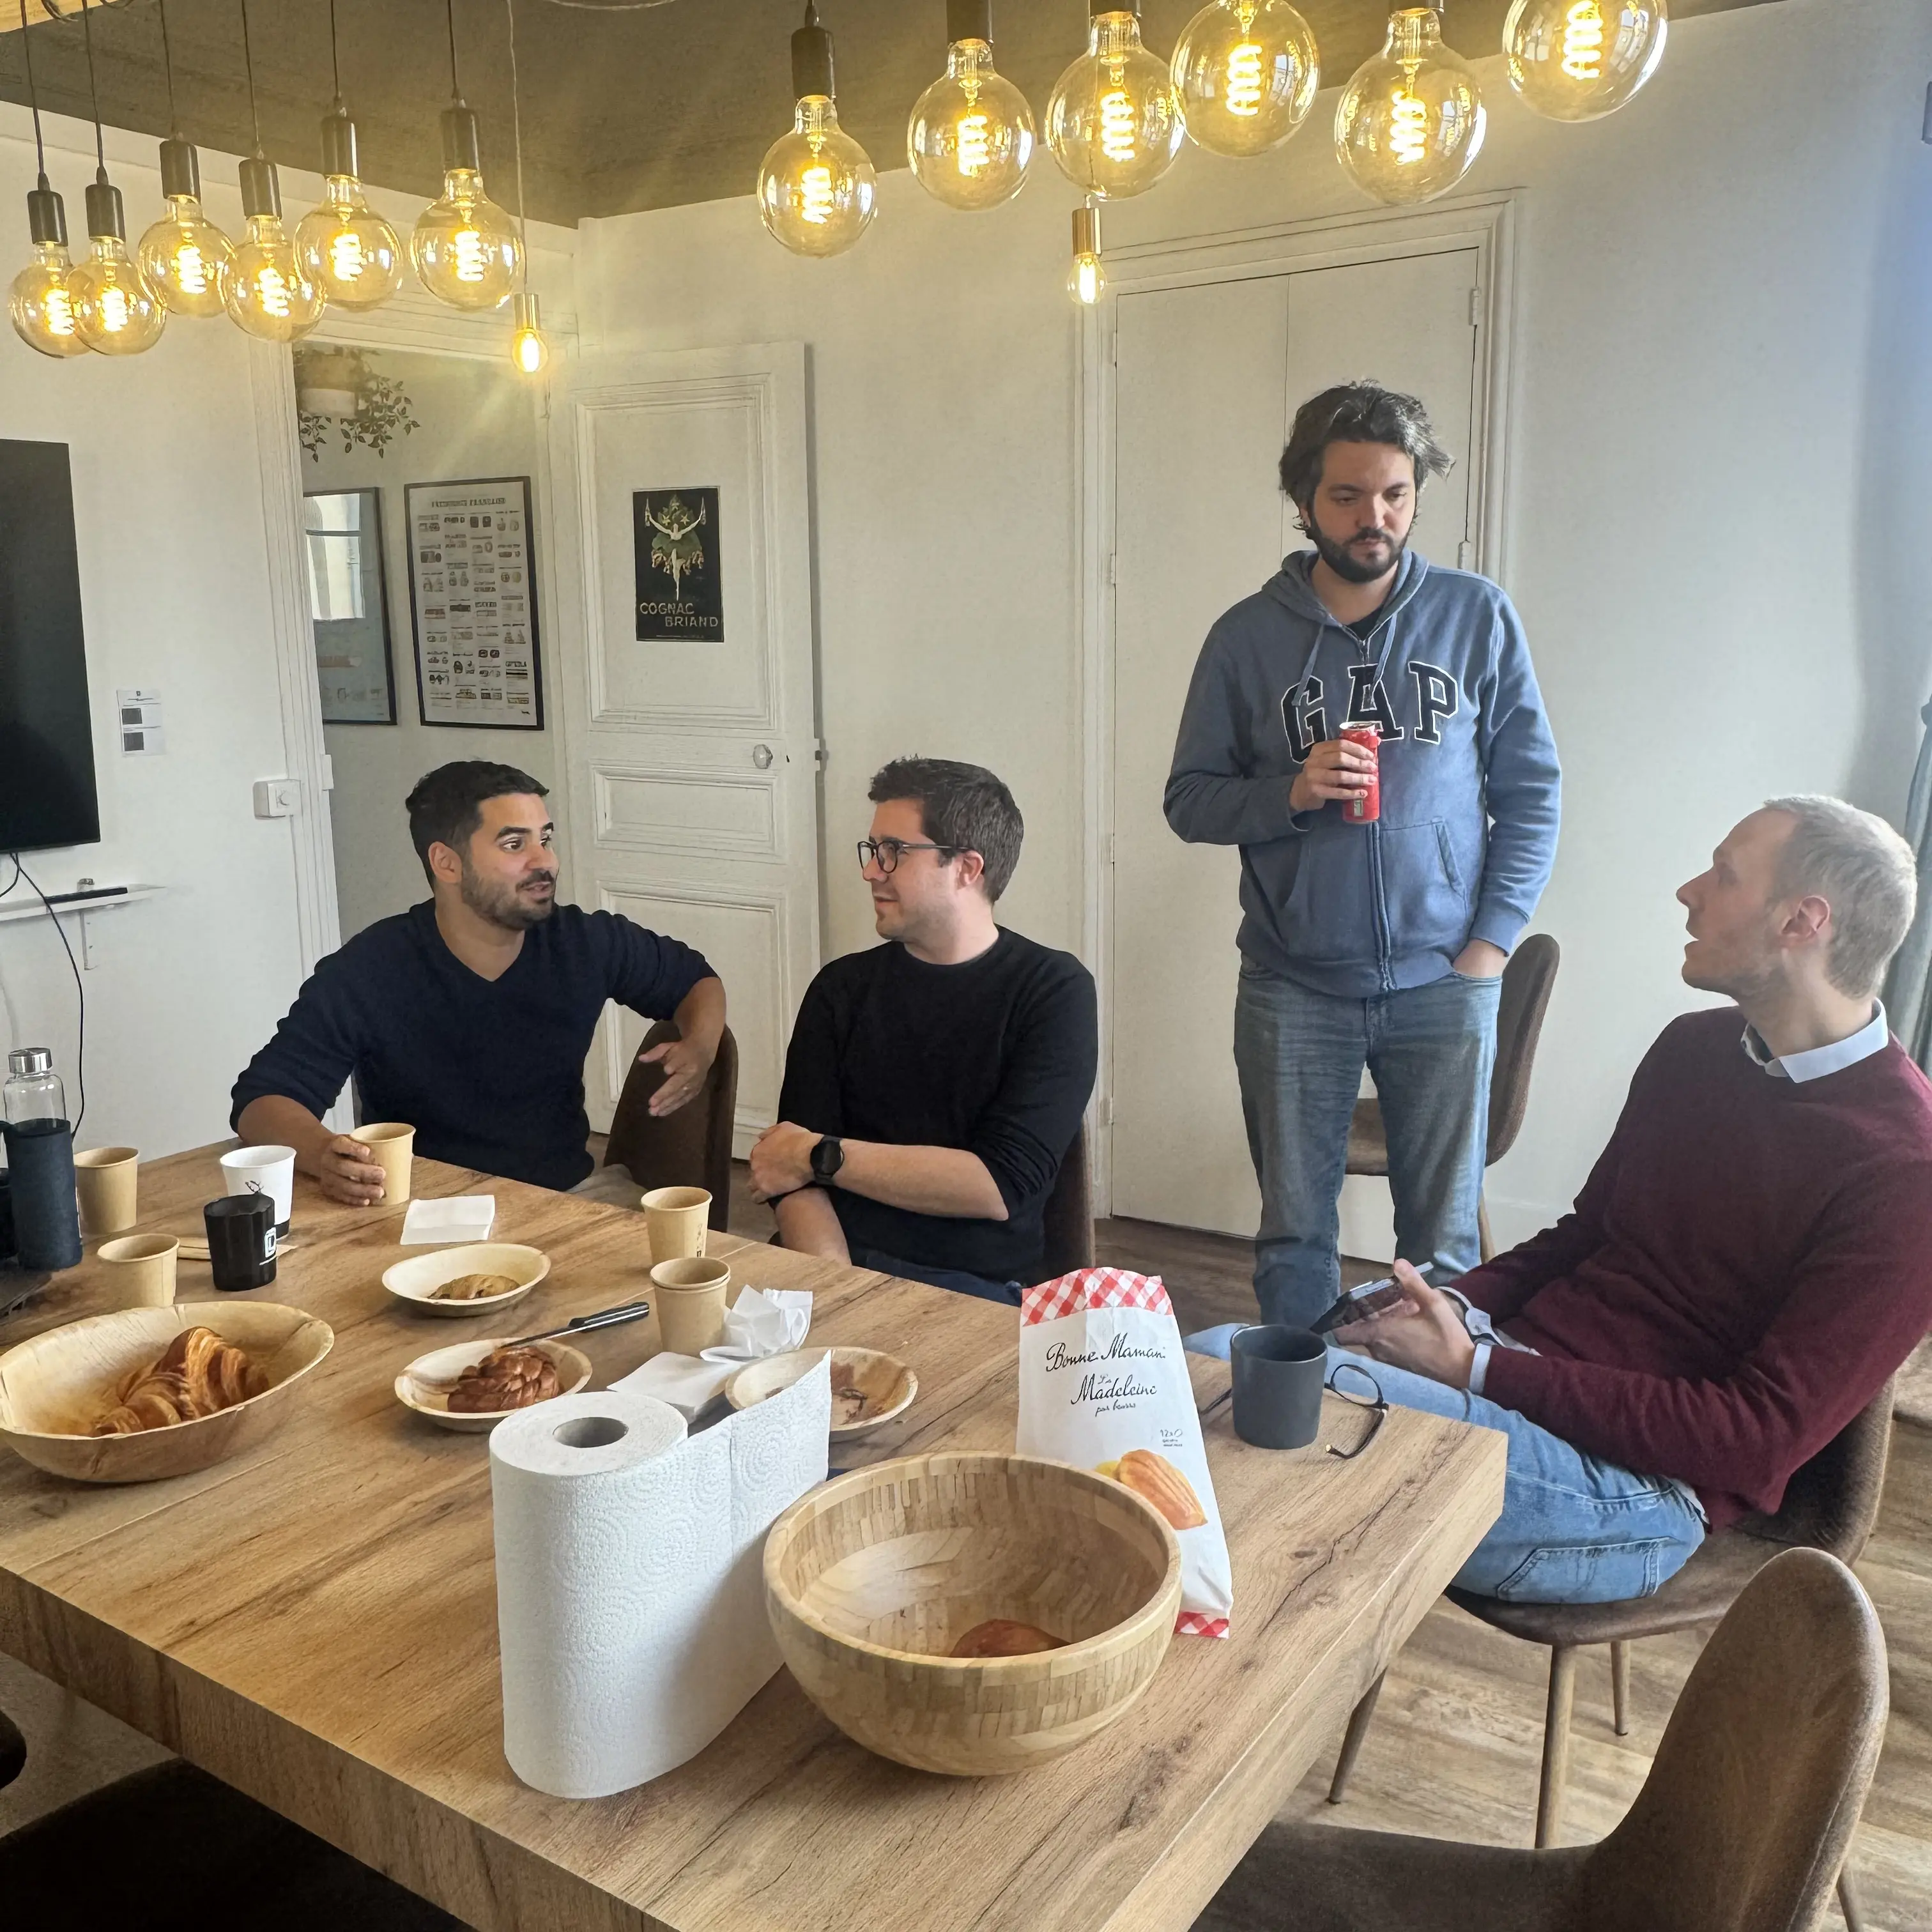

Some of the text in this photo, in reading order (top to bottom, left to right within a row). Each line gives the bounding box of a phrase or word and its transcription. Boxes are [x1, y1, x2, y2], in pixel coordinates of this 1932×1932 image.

[640, 602, 694, 615] COGNAC
[665, 616, 719, 627] BRIAND
[1281, 661, 1459, 764] GAP
[1046, 1332, 1166, 1372] Bonne Maman
[1071, 1373, 1158, 1405] Madeleine
